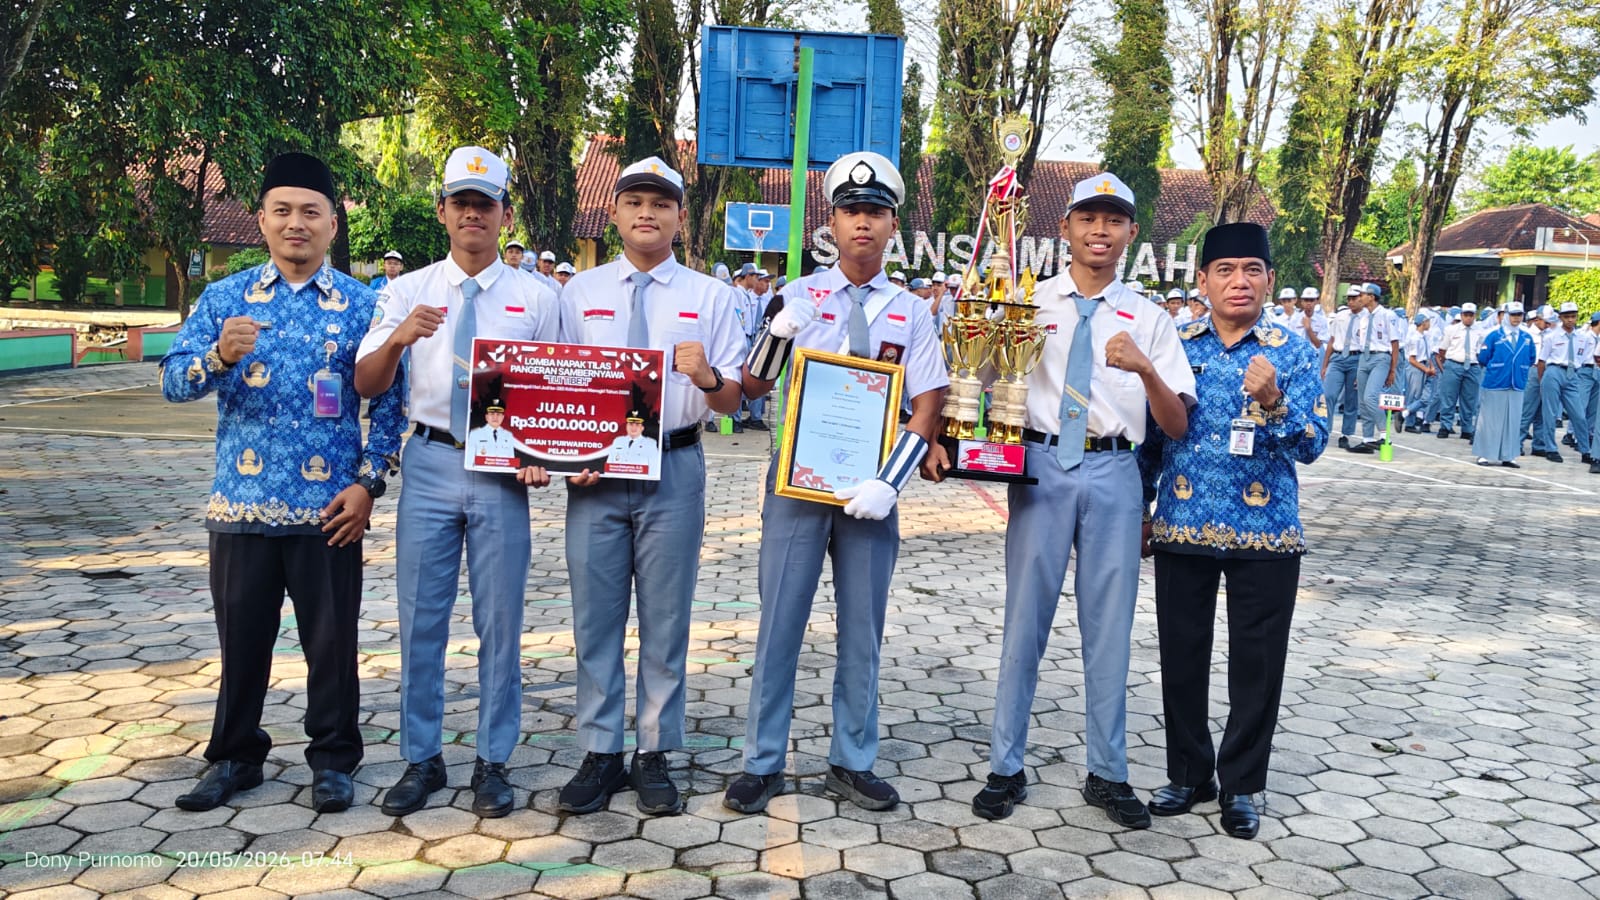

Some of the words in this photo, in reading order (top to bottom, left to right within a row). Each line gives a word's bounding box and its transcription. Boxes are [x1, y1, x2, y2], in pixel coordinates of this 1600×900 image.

[524, 357, 556, 367] LOMBA
[556, 359, 586, 368] NAPAK
[587, 361, 612, 370] TILAS
[510, 364, 557, 375] PANGERAN
[558, 367, 625, 380] SAMBERNYAWA
[536, 402, 586, 415] JUARA
[590, 404, 596, 415] I
[510, 415, 619, 434] Rp3.000.000,00
[525, 438, 547, 446] SMAN
[552, 440, 603, 449] PURWANTORO
[547, 447, 579, 456] PELAJAR
